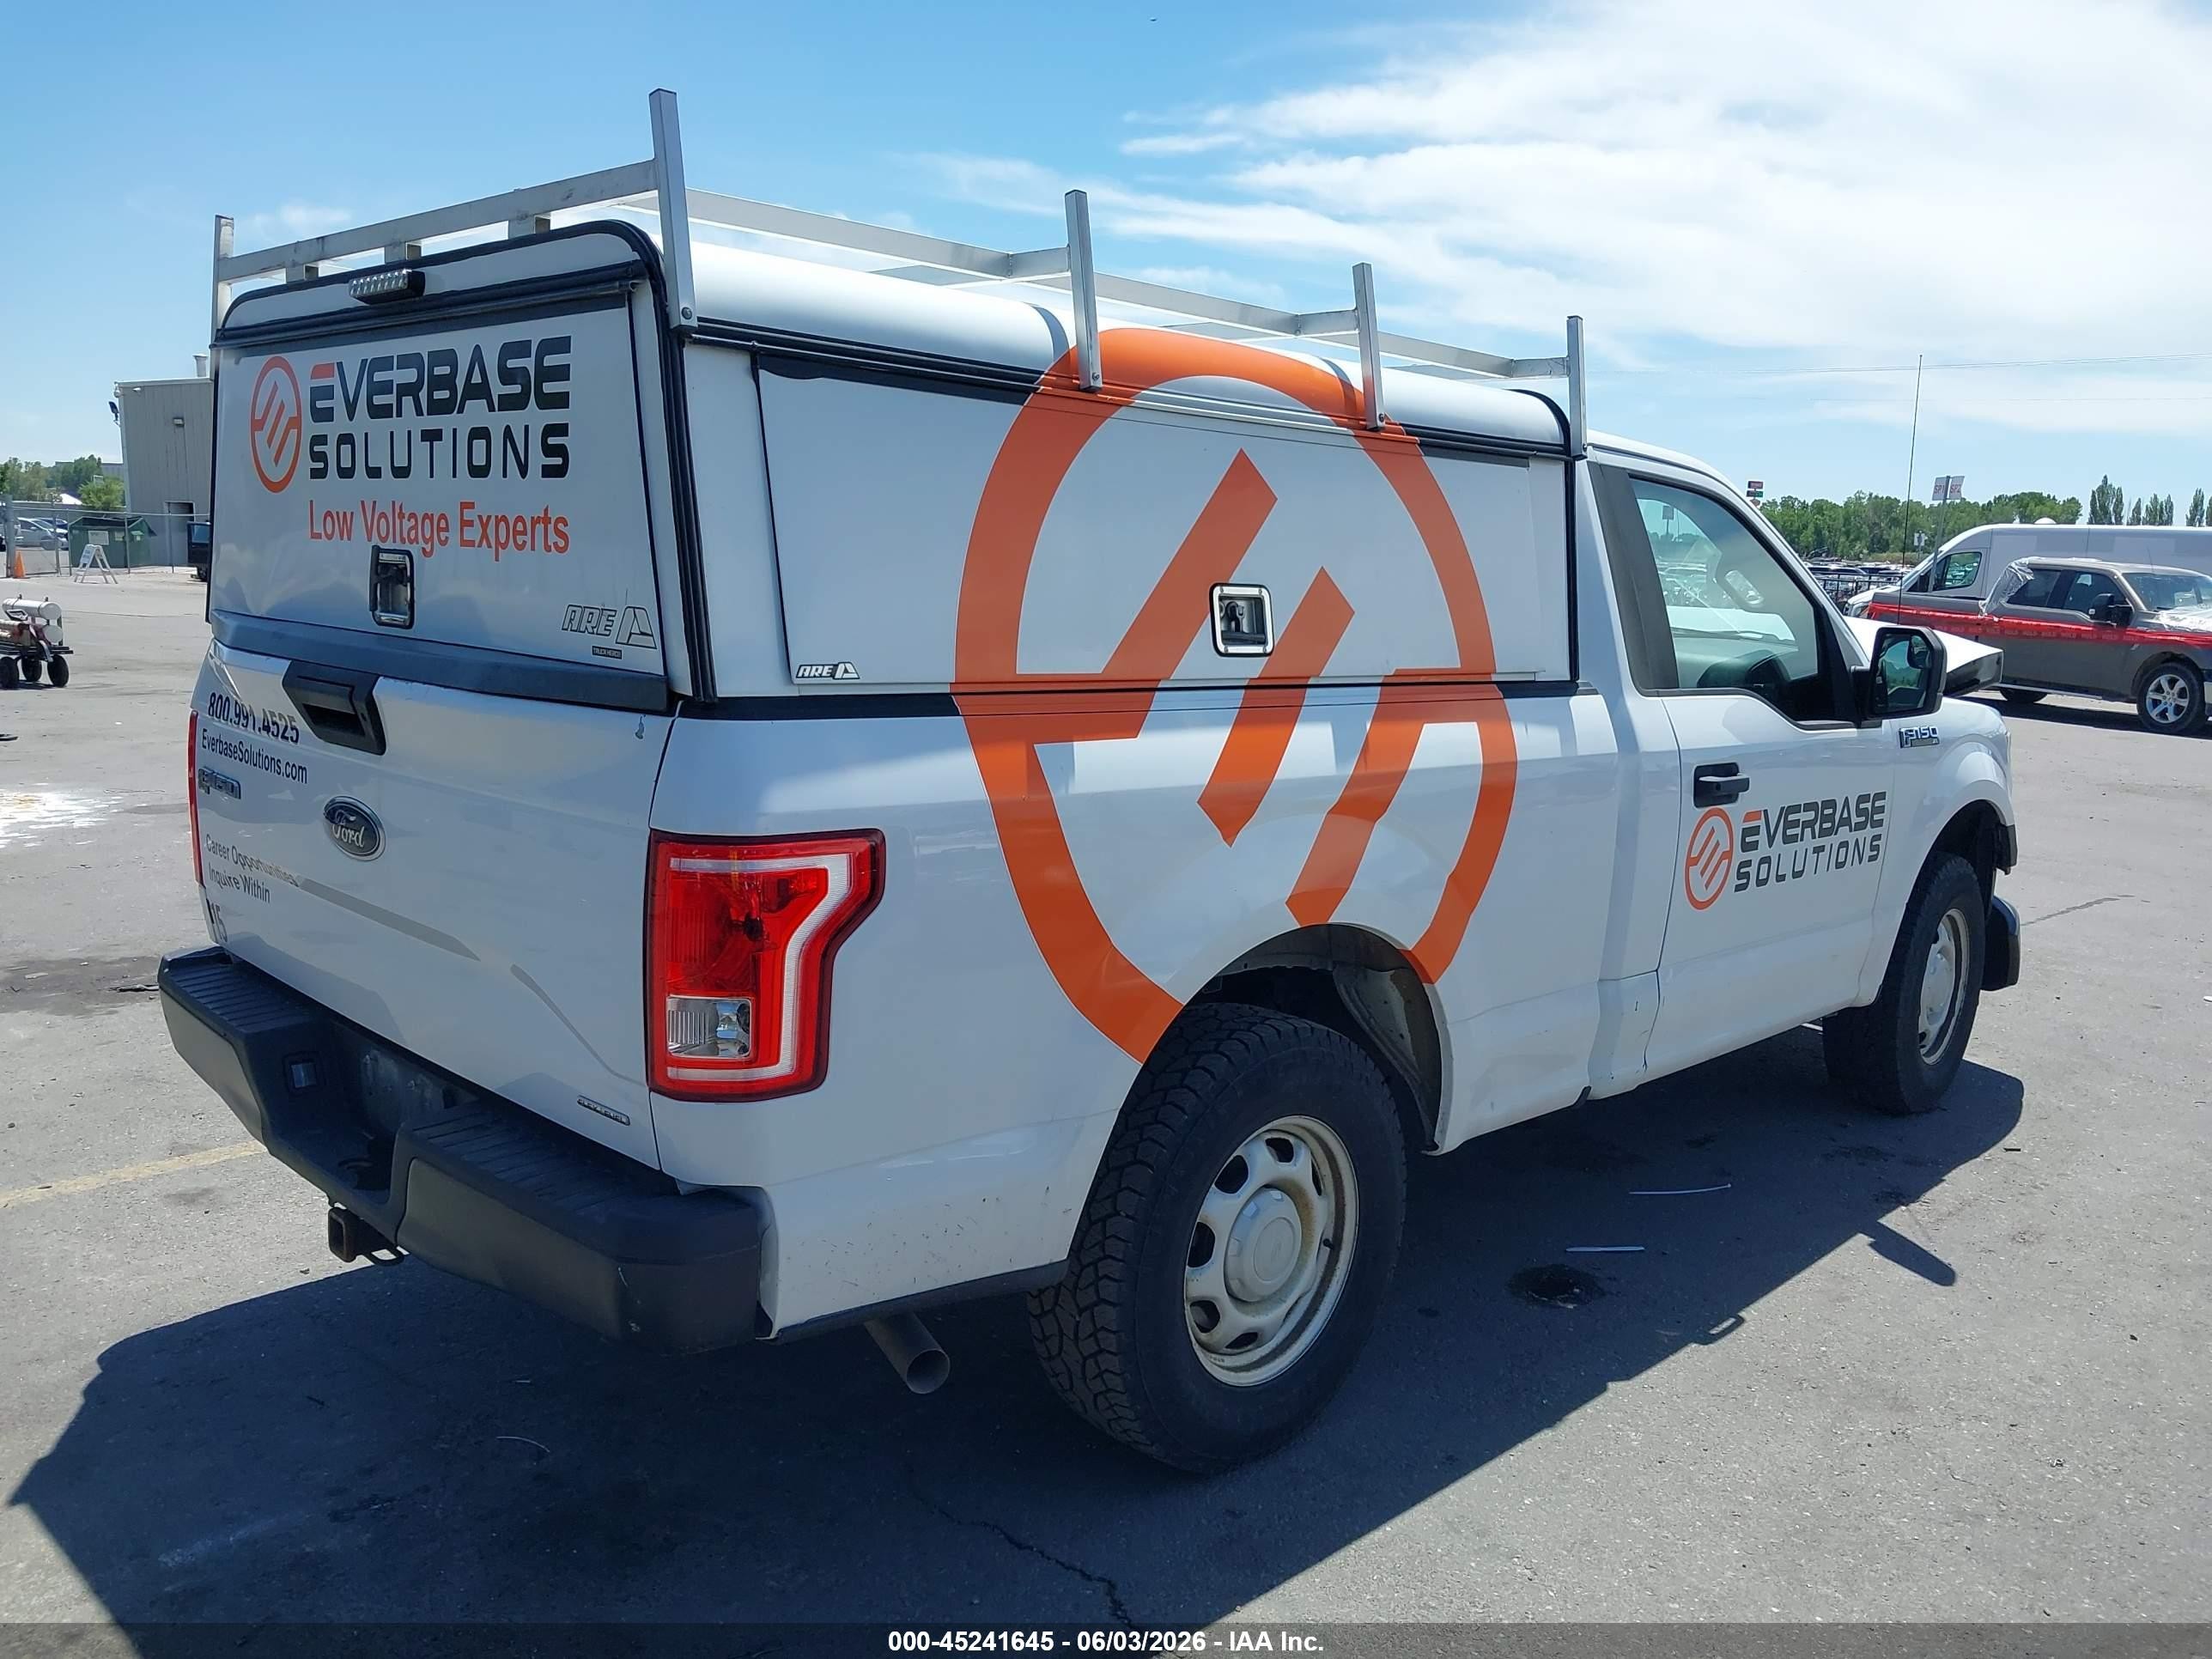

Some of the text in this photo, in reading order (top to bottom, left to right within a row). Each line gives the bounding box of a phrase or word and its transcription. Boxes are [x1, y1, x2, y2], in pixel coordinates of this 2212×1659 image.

[310, 336, 572, 423] EVERBASE
[309, 422, 570, 480] SOLUTIONS
[309, 500, 570, 562] Low Voltage Experts
[562, 604, 618, 637] ARE
[797, 665, 834, 678] ARE
[208, 692, 300, 744] 800.991.4525
[202, 727, 307, 784] EverbaseSolutions.com
[206, 834, 230, 861] Career
[332, 809, 365, 848] Ford
[1741, 791, 1887, 853] EVERBASE
[209, 863, 270, 903] Inquire Within
[1734, 834, 1882, 893] SOLUTIONS
